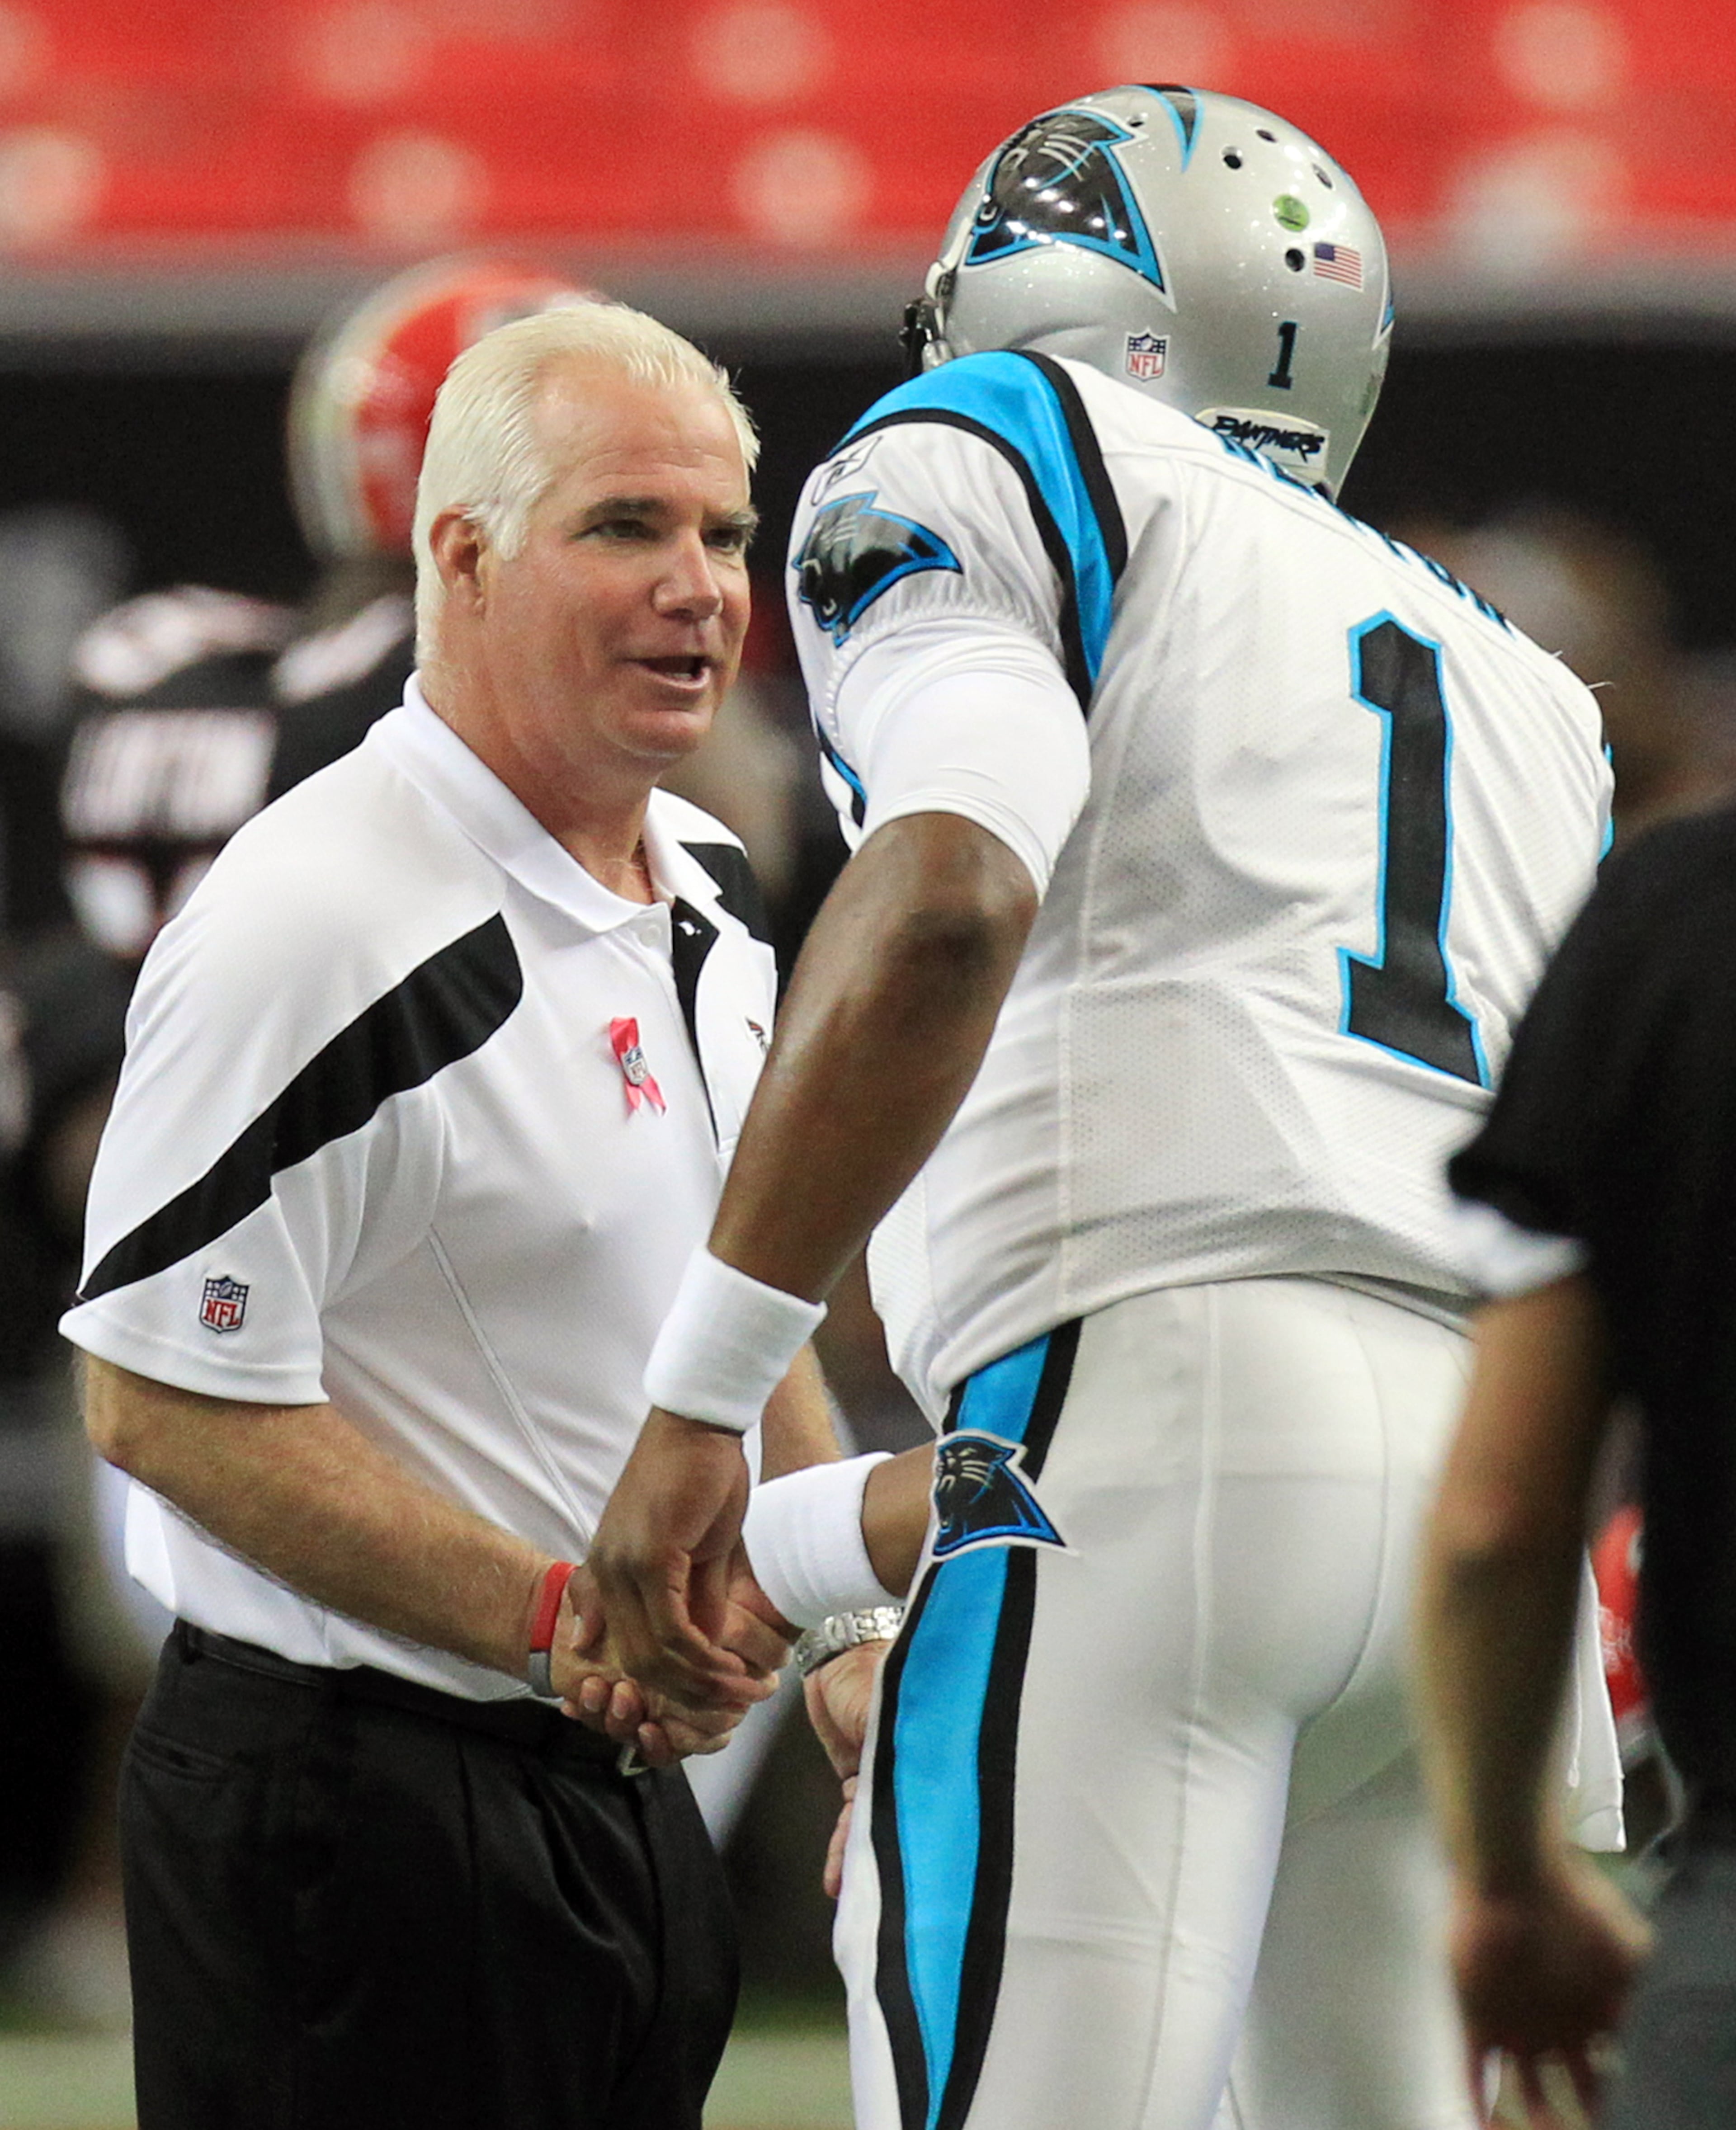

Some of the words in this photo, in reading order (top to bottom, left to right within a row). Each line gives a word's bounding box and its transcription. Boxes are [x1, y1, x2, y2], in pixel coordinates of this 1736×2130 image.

[1128, 353, 1164, 376] NFL
[1268, 321, 1297, 390] 1
[1212, 415, 1325, 463] PANTHERS
[1336, 608, 1492, 1090] 1
[202, 1298, 241, 1328] NFL
